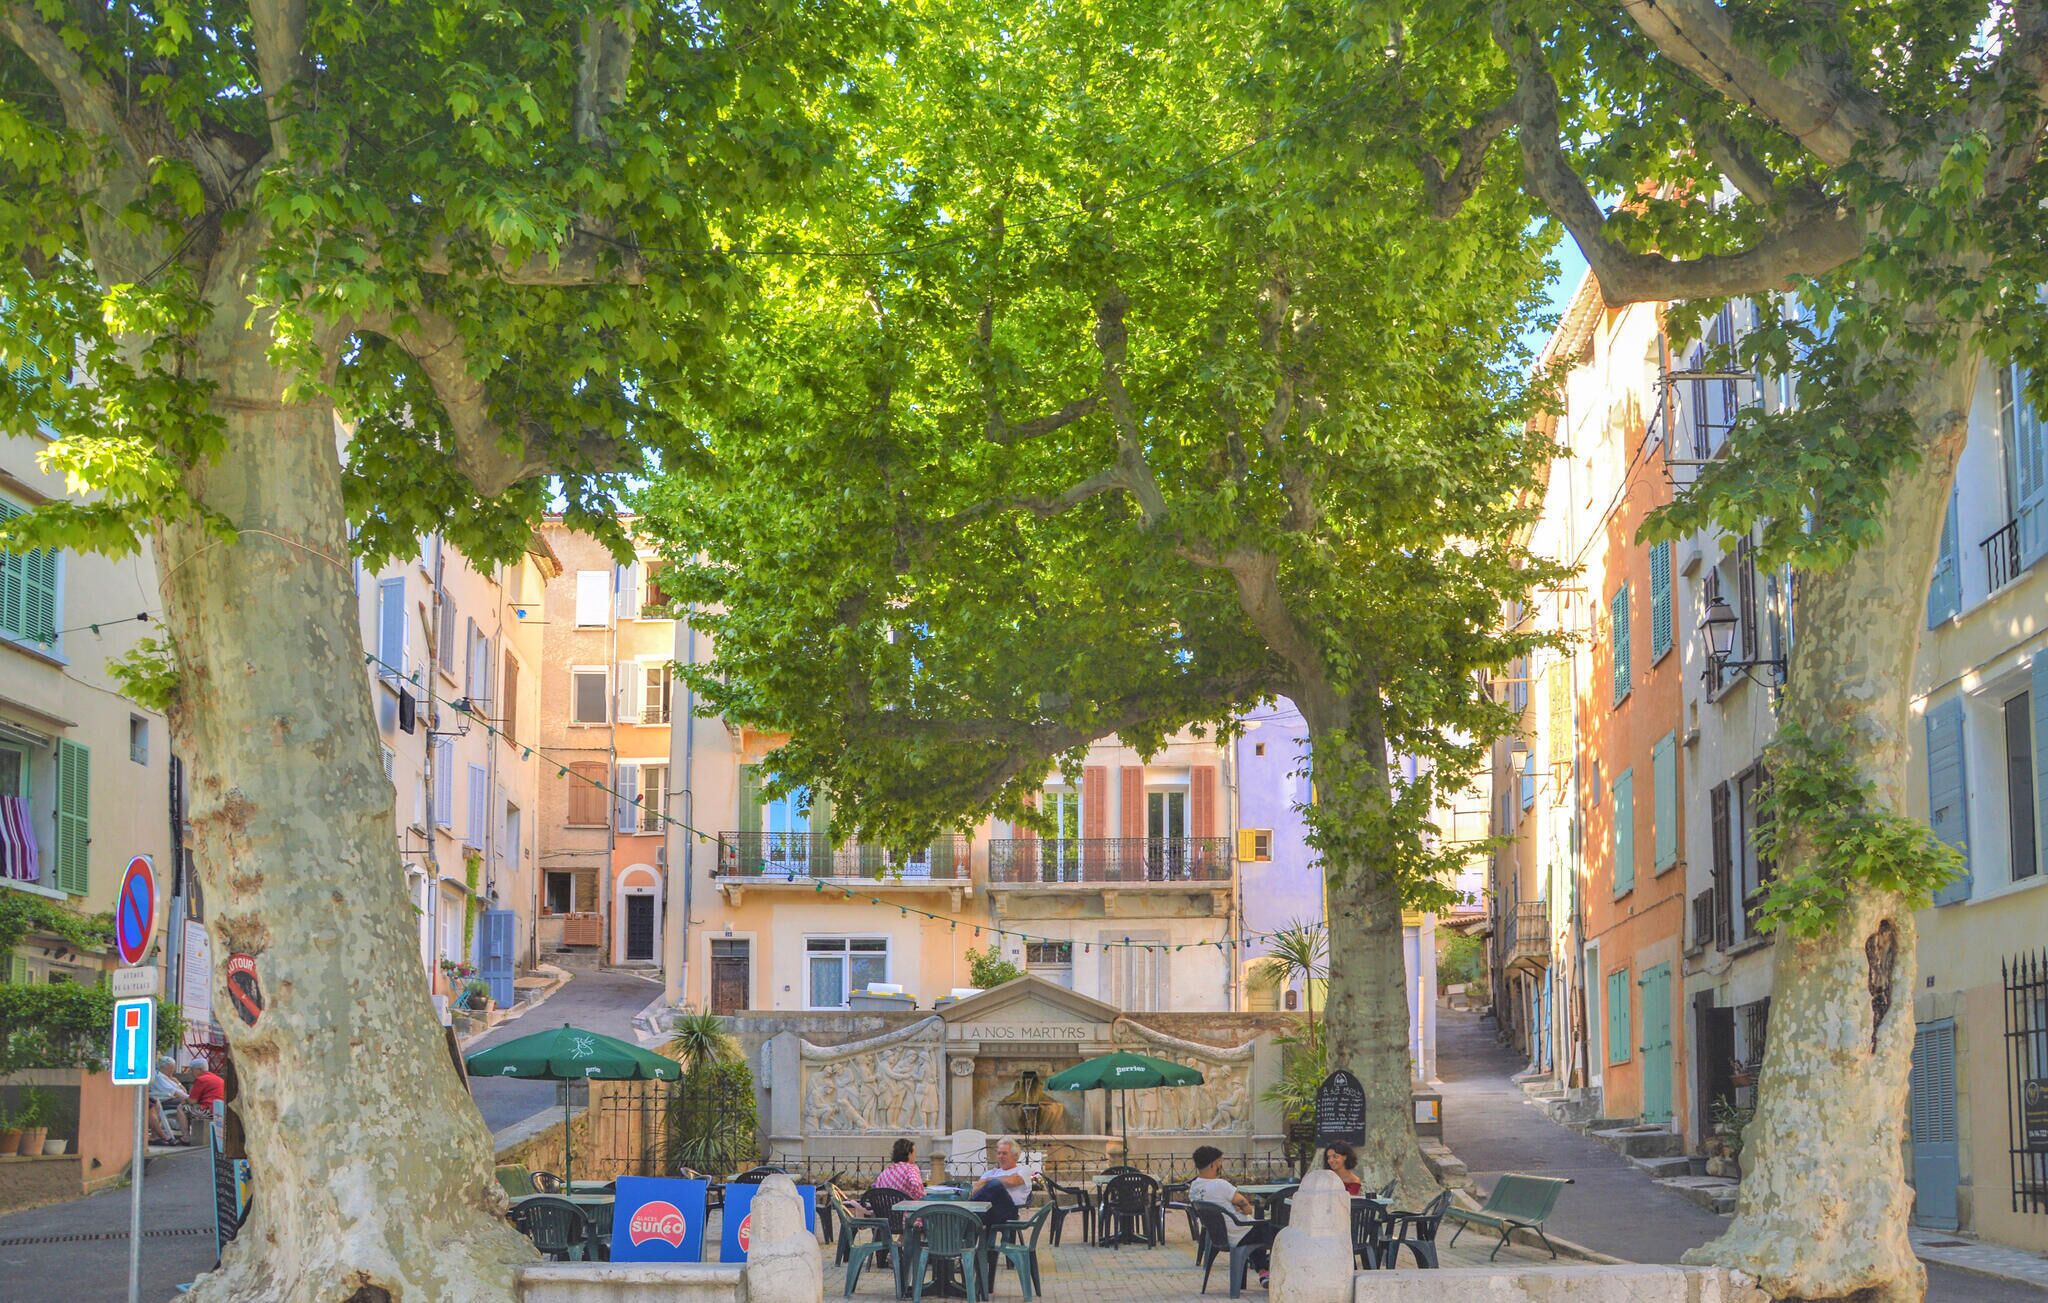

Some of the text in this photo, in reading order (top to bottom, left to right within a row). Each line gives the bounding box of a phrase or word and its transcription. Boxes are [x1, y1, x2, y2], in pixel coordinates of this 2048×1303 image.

[228, 957, 254, 973] UTOUR
[971, 1026, 1086, 1039] A NOS MARTYRS
